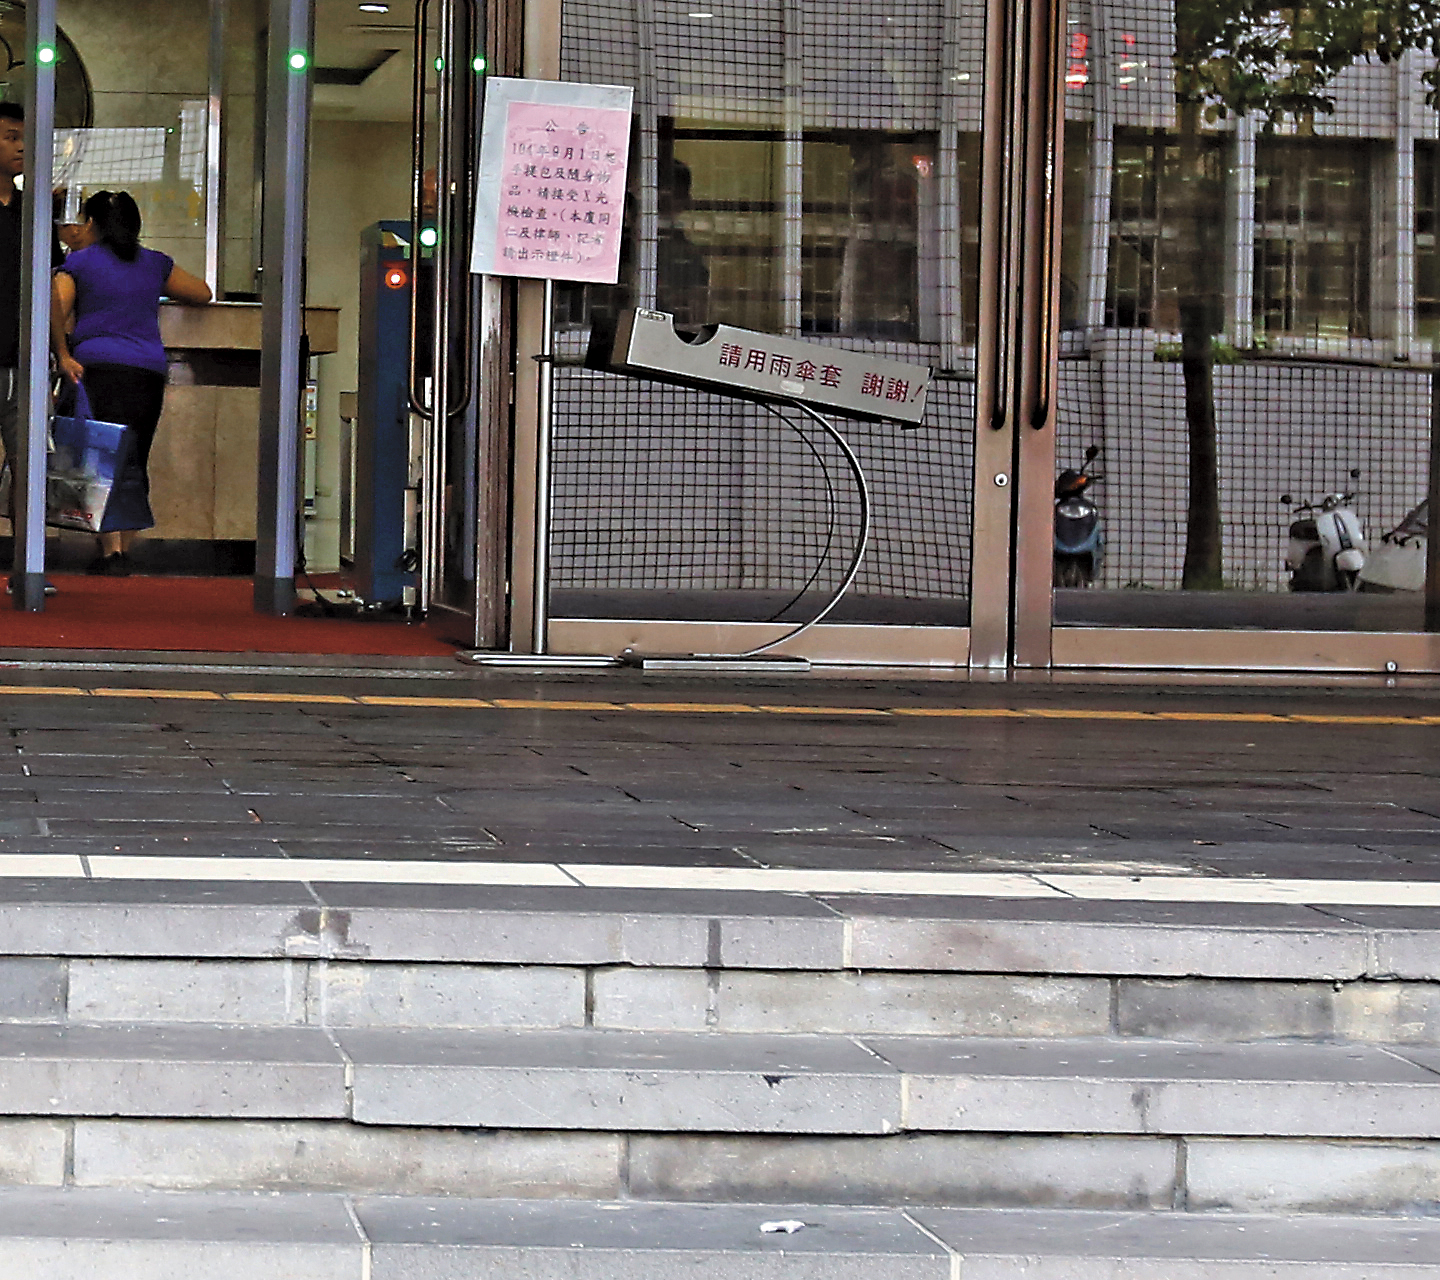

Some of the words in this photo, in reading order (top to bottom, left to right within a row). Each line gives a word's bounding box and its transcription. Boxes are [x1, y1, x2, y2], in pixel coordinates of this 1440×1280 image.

[719, 342, 843, 390] 請用雨傘套
